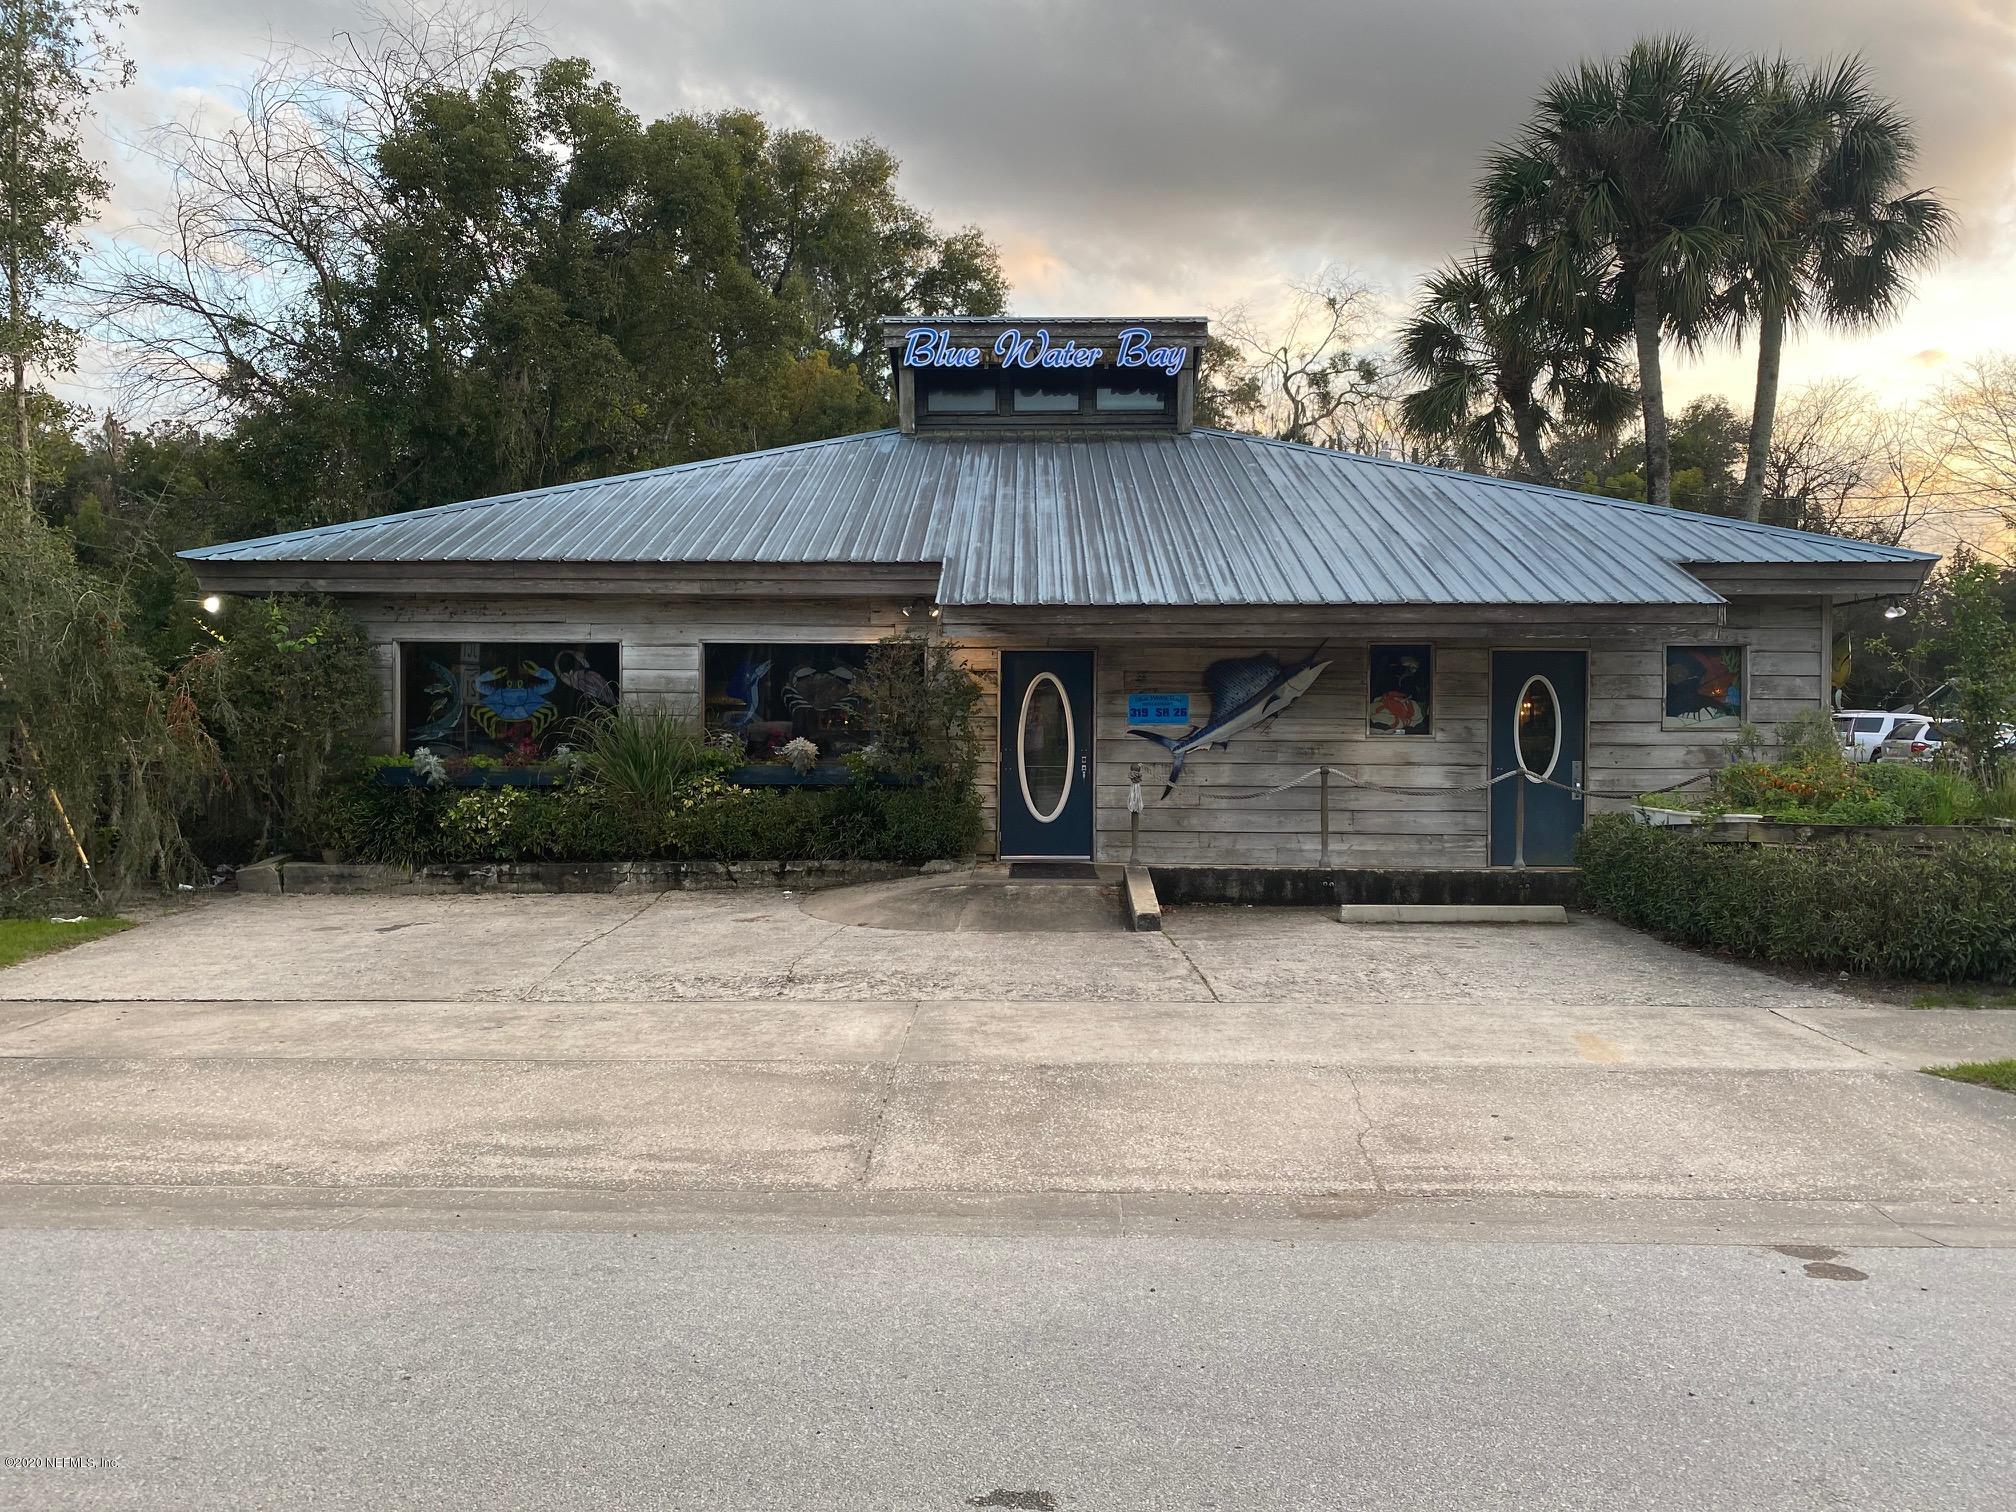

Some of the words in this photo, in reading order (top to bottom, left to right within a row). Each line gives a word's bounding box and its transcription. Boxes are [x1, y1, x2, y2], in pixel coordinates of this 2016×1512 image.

[903, 327, 980, 368] Blue
[995, 329, 1103, 369] Water
[1117, 327, 1187, 376] Bay
